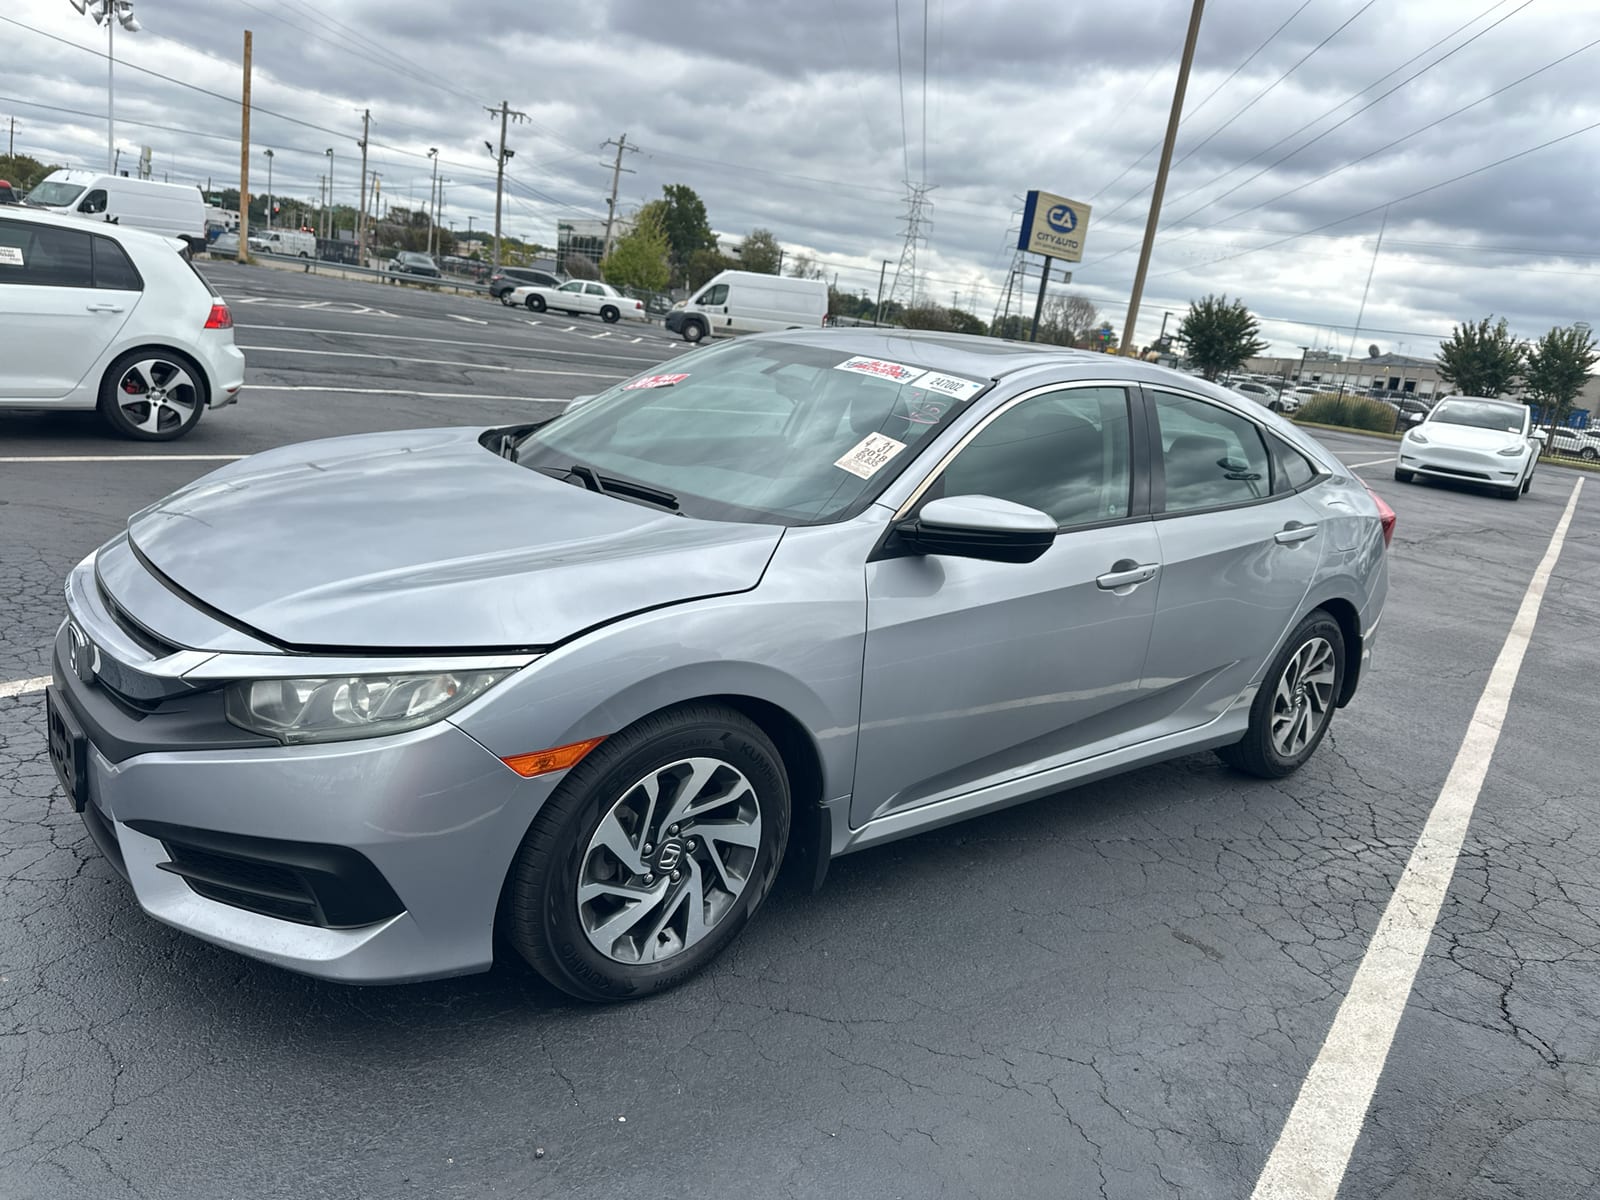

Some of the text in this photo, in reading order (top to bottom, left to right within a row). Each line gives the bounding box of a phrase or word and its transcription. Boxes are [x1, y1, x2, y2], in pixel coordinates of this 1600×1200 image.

[1049, 208, 1073, 228] CA
[929, 377, 965, 392] 247002
[860, 447, 888, 463] 2018
[877, 442, 896, 455] 31
